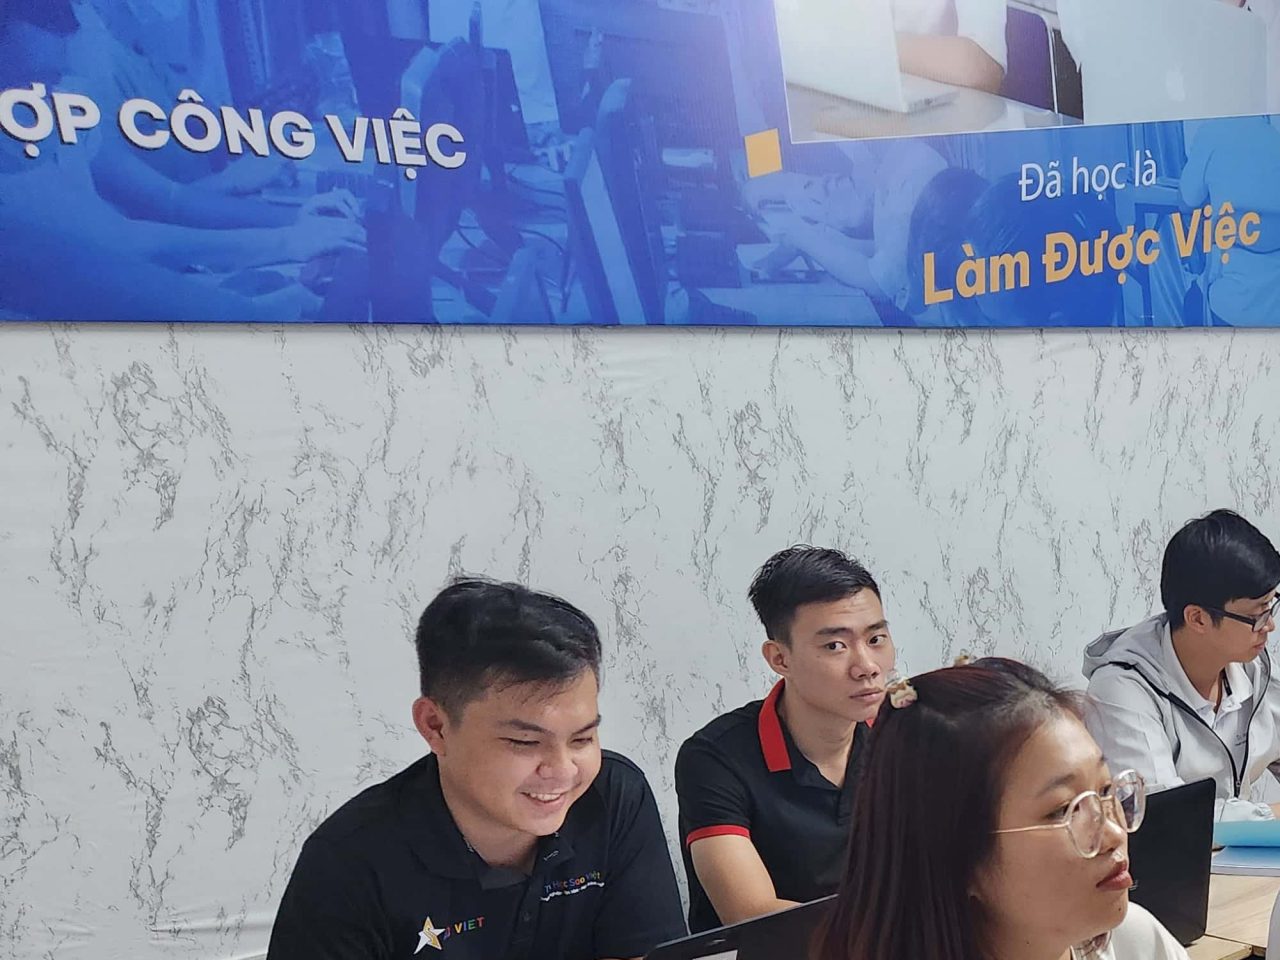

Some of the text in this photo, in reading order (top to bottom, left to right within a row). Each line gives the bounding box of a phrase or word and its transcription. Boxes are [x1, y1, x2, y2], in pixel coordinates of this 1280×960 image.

[118, 89, 317, 159] CÔNG
[325, 107, 468, 180] VIỆC
[1018, 150, 1157, 202] Đã học là
[924, 201, 1262, 306] Làm Được Việc
